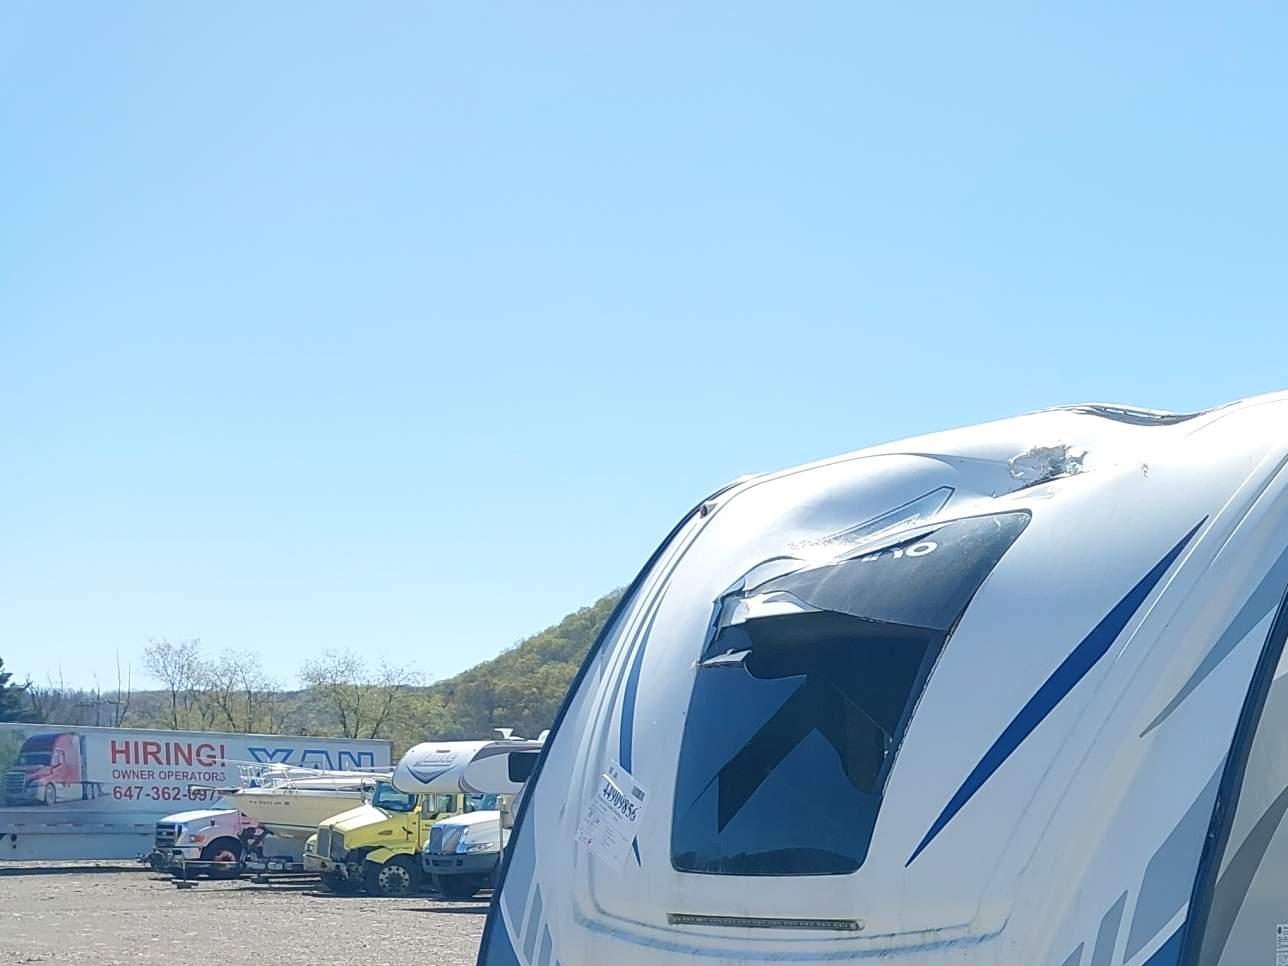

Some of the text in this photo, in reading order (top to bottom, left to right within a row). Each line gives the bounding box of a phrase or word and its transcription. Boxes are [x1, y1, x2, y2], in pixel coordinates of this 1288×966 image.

[110, 739, 226, 768] HIRING!
[112, 769, 226, 782] OWNER OPERATORS
[112, 785, 218, 801] 647-362-697
